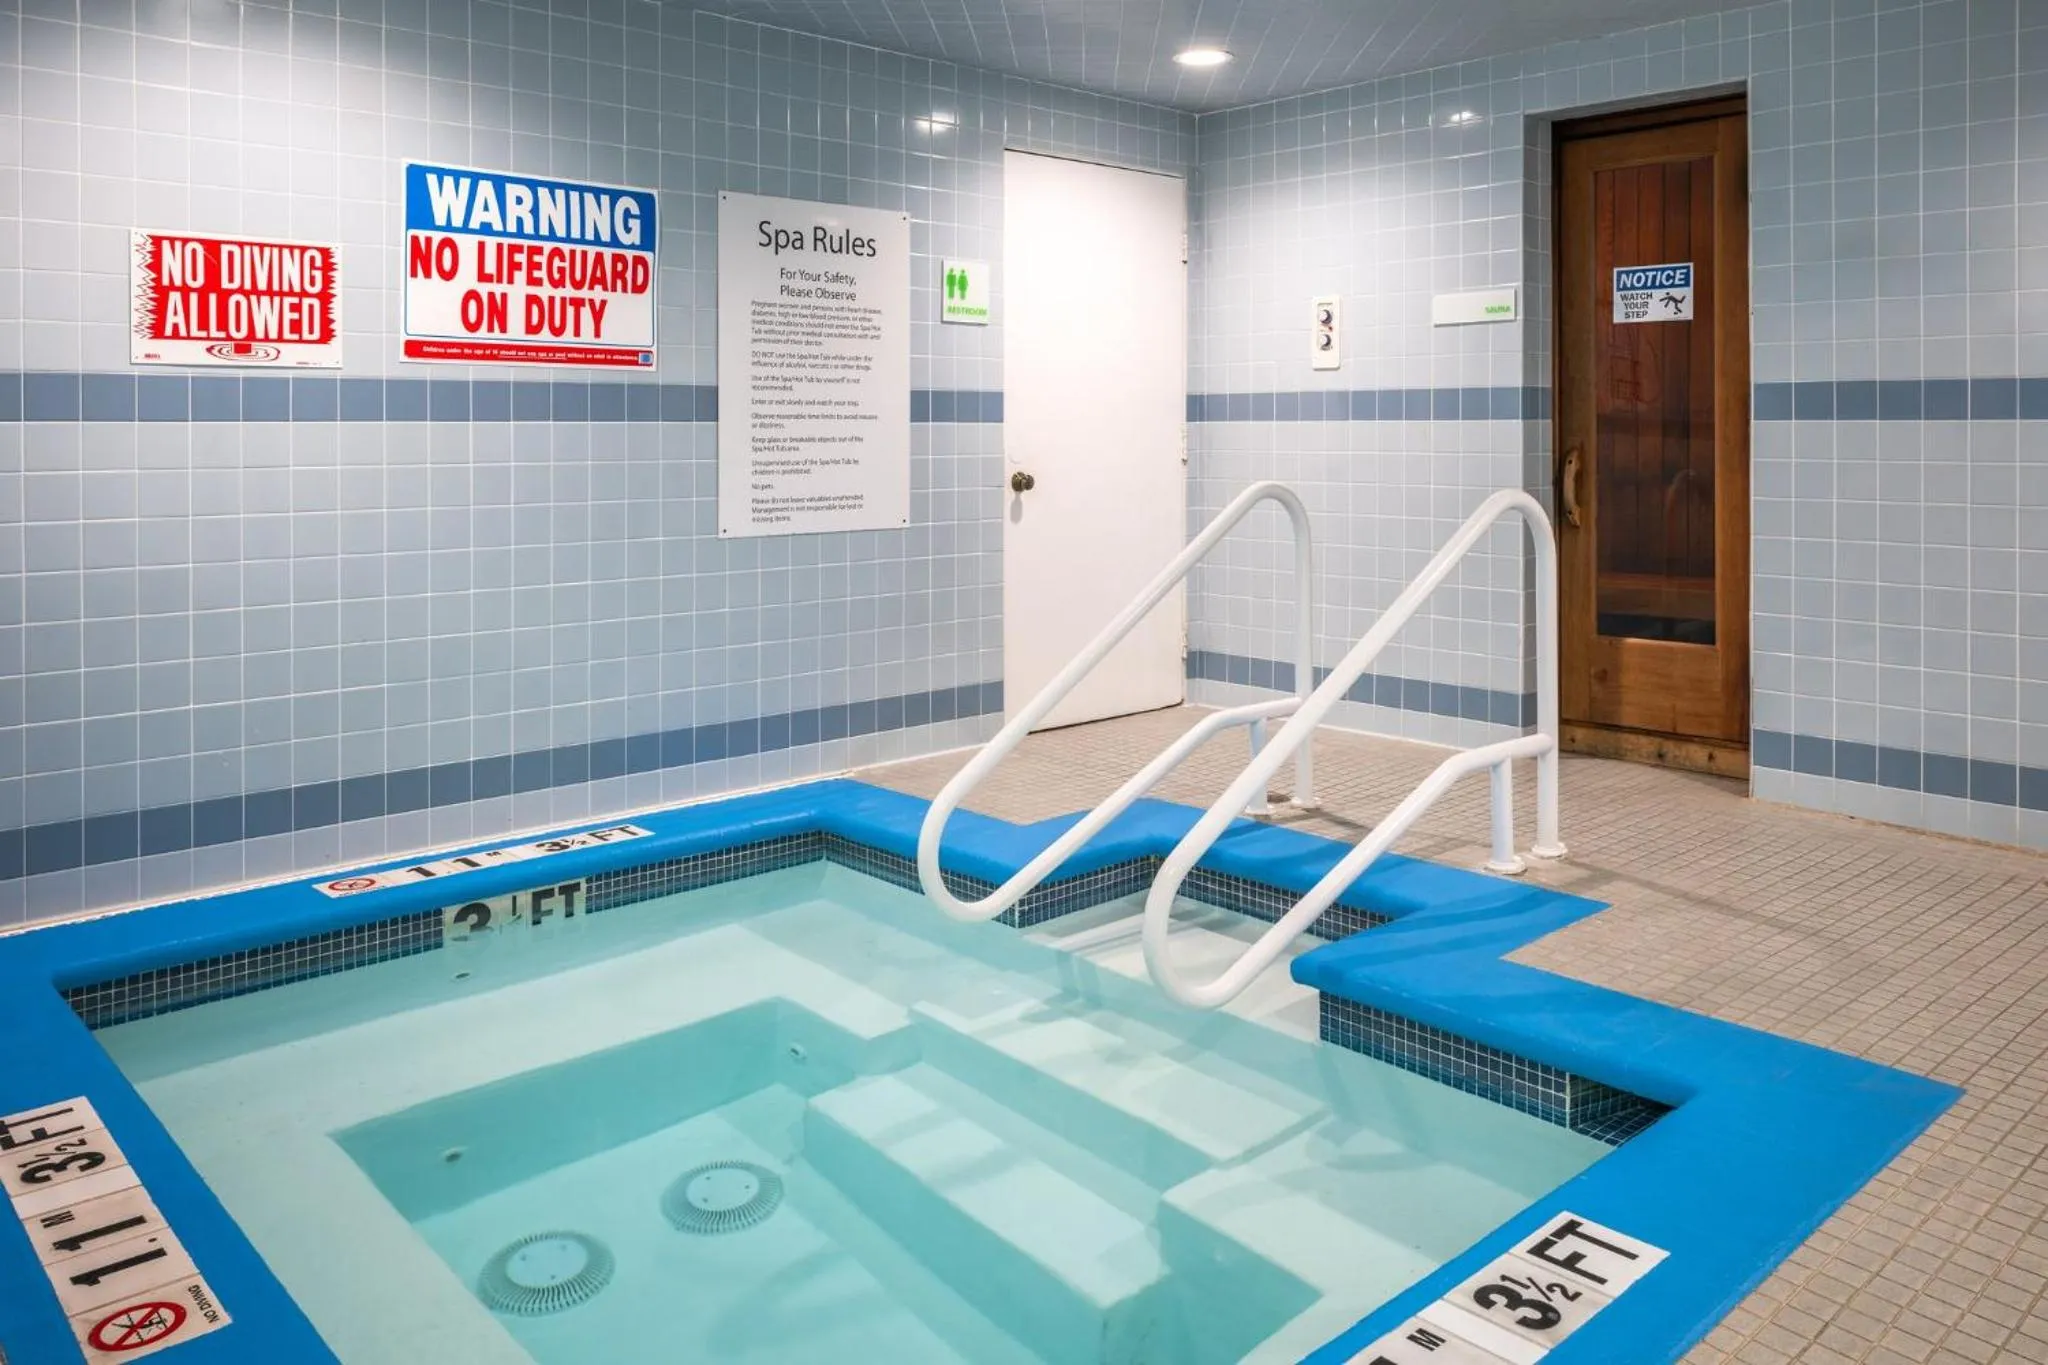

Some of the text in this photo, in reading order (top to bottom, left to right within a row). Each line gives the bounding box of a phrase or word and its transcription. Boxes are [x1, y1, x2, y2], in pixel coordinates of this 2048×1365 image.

[426, 173, 641, 245] WARNING
[759, 220, 876, 257] Spa Rules
[161, 239, 323, 294] NO DIVING
[410, 234, 650, 294] NO LIFEGUARD
[780, 268, 797, 280] For
[798, 270, 821, 282] Your
[1620, 269, 1687, 288] NOTICE
[780, 285, 856, 301] Please Observe
[1621, 292, 1653, 302] WATCH
[1623, 301, 1650, 311] YOUR
[164, 291, 321, 340] ALLOWED
[461, 289, 608, 339] ON DUTY
[1624, 310, 1649, 319] STEP
[588, 825, 640, 841] FT
[532, 881, 582, 926] FT
[0, 1107, 85, 1151] FT
[188, 1284, 221, 1324] NO DIVING
[1406, 1328, 1447, 1352] M
[1526, 1219, 1640, 1286] FT
